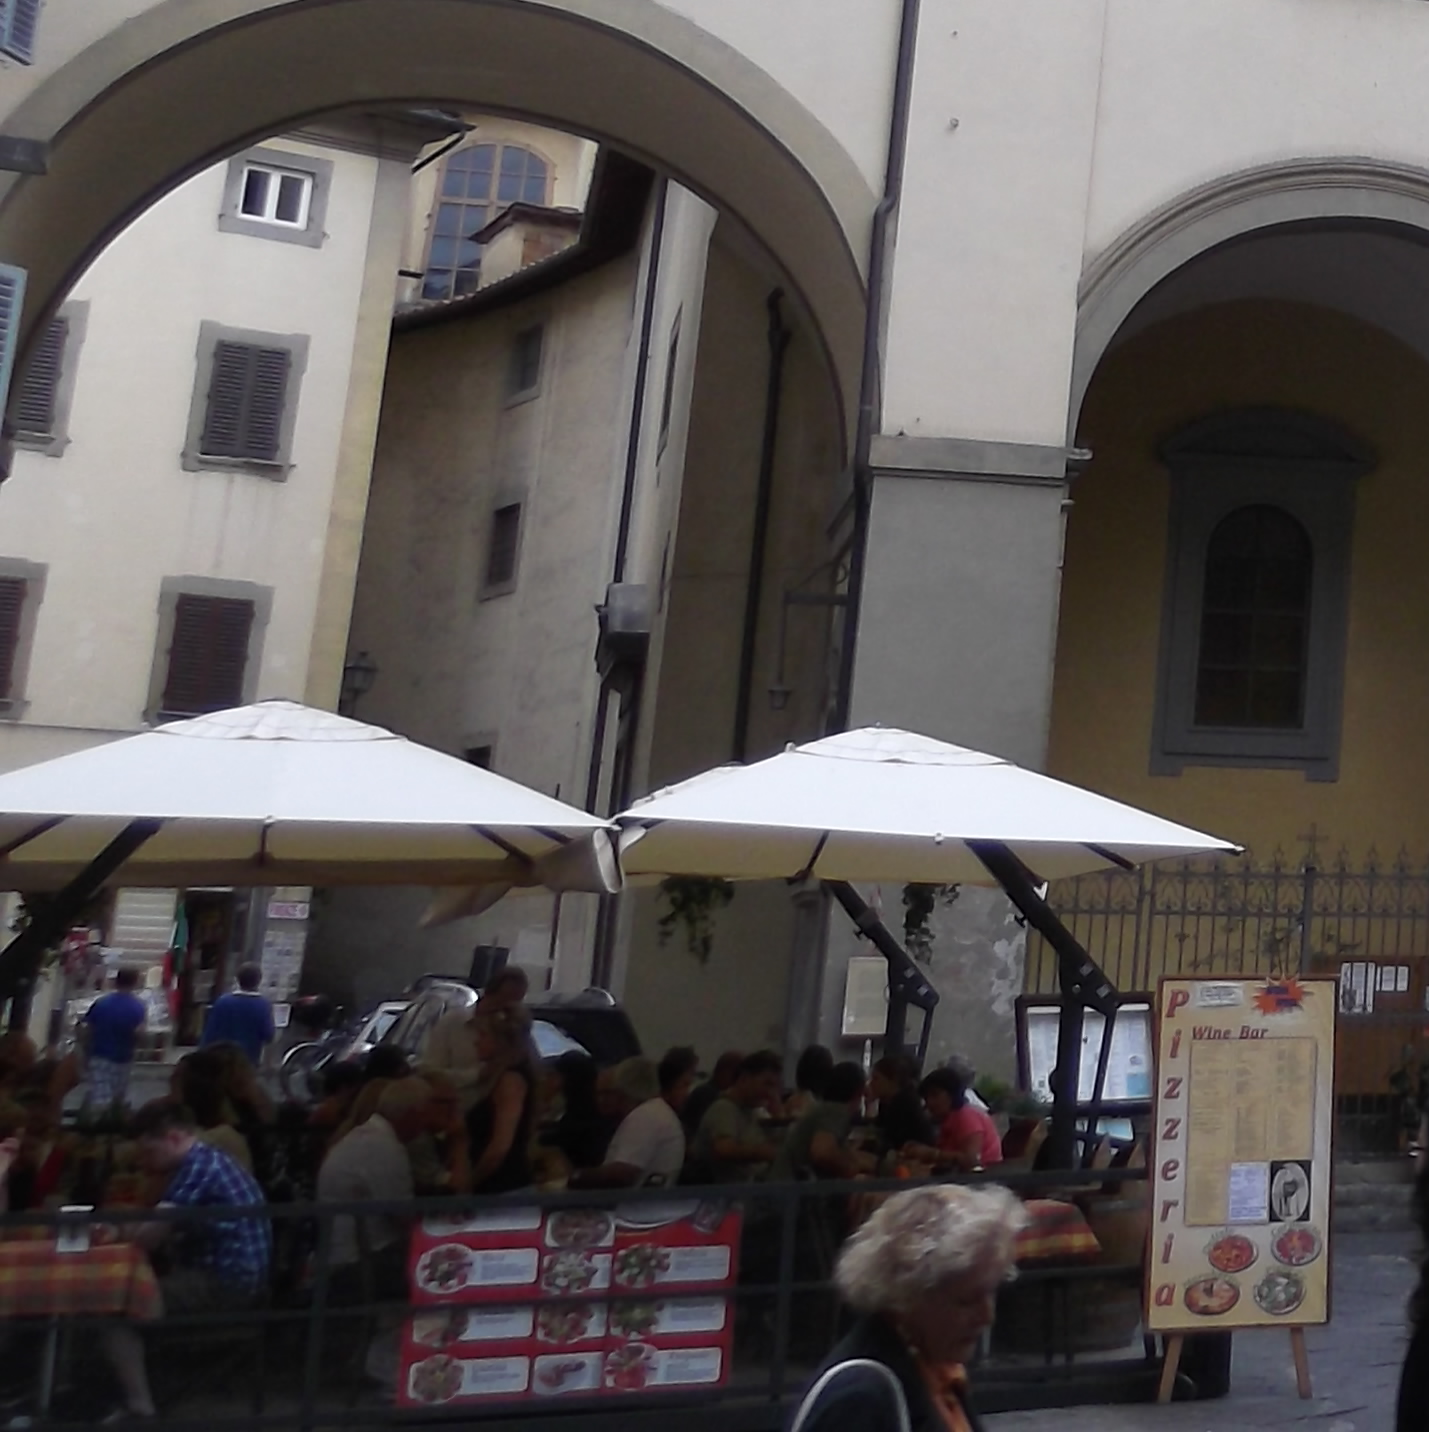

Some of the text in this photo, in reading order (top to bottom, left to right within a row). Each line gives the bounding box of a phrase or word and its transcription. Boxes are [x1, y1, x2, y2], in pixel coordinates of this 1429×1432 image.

[1192, 1025, 1268, 1040] Wine Bar
[1155, 989, 1190, 1306] Pizzeria
